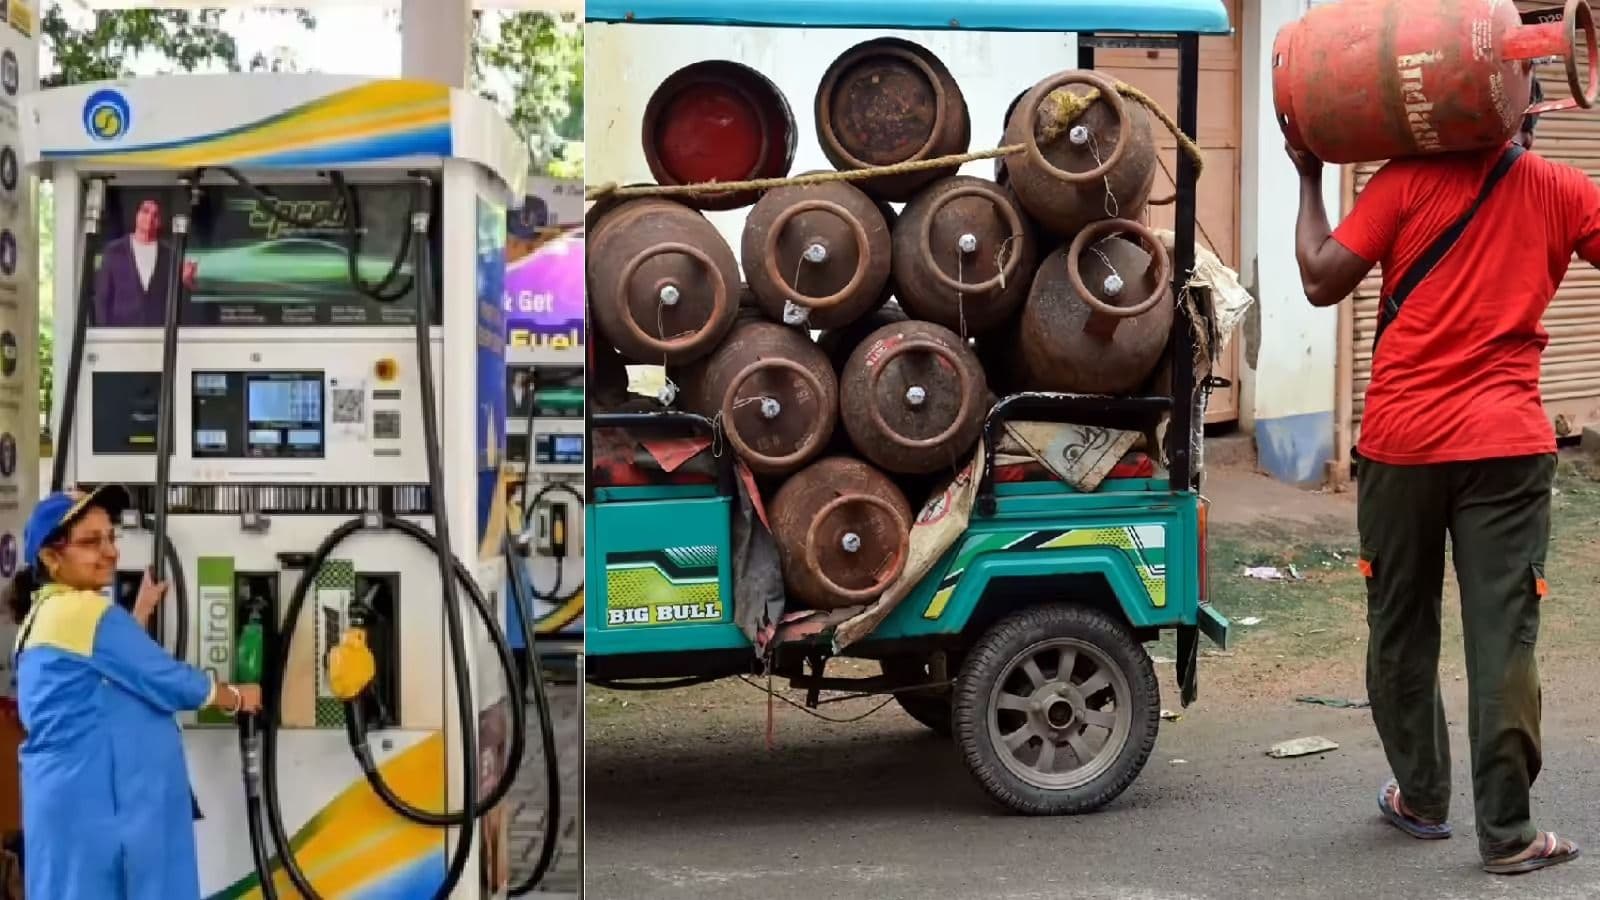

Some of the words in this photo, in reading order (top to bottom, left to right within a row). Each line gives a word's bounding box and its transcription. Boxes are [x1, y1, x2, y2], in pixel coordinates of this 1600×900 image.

[519, 289, 554, 313] Get
[510, 327, 578, 350] Fuel
[608, 607, 649, 624] BIG
[656, 603, 721, 621] BULL
